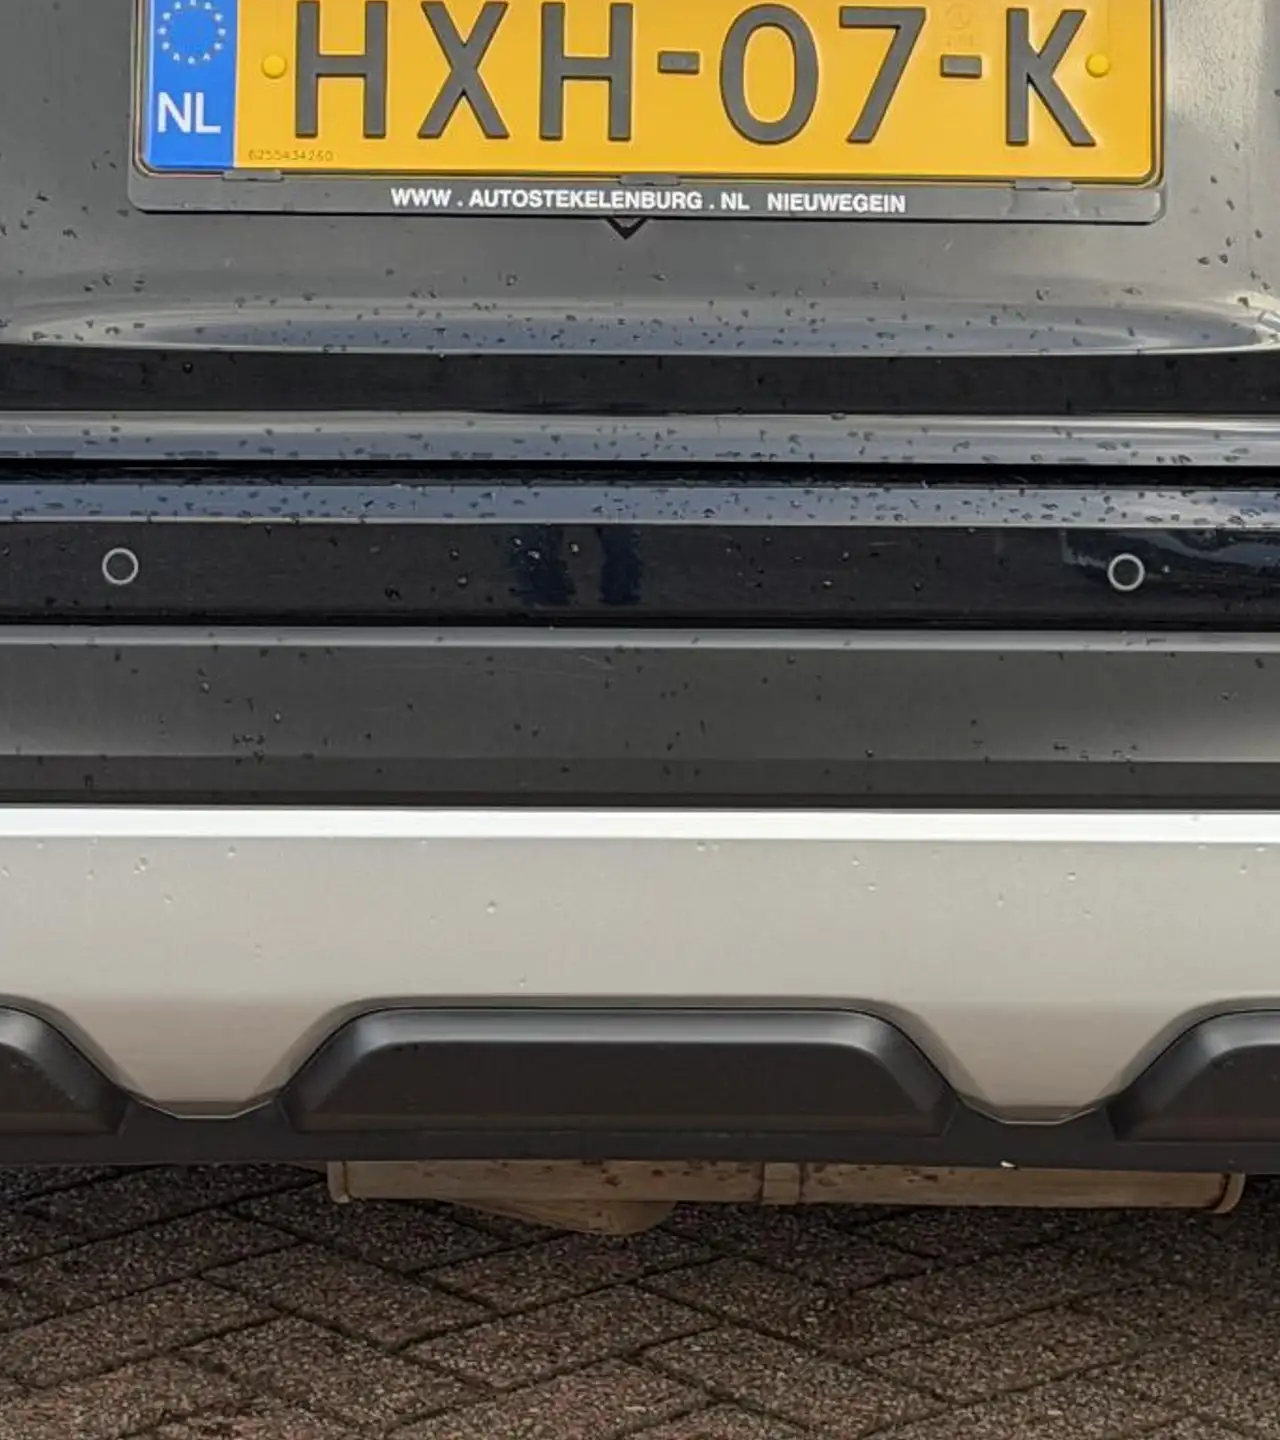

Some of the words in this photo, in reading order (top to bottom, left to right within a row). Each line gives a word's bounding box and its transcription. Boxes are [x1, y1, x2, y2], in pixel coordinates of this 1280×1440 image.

[295, 0, 1096, 148] HXH-07-K
[158, 92, 221, 133] NL
[767, 192, 906, 213] NIEUWEGEIN
